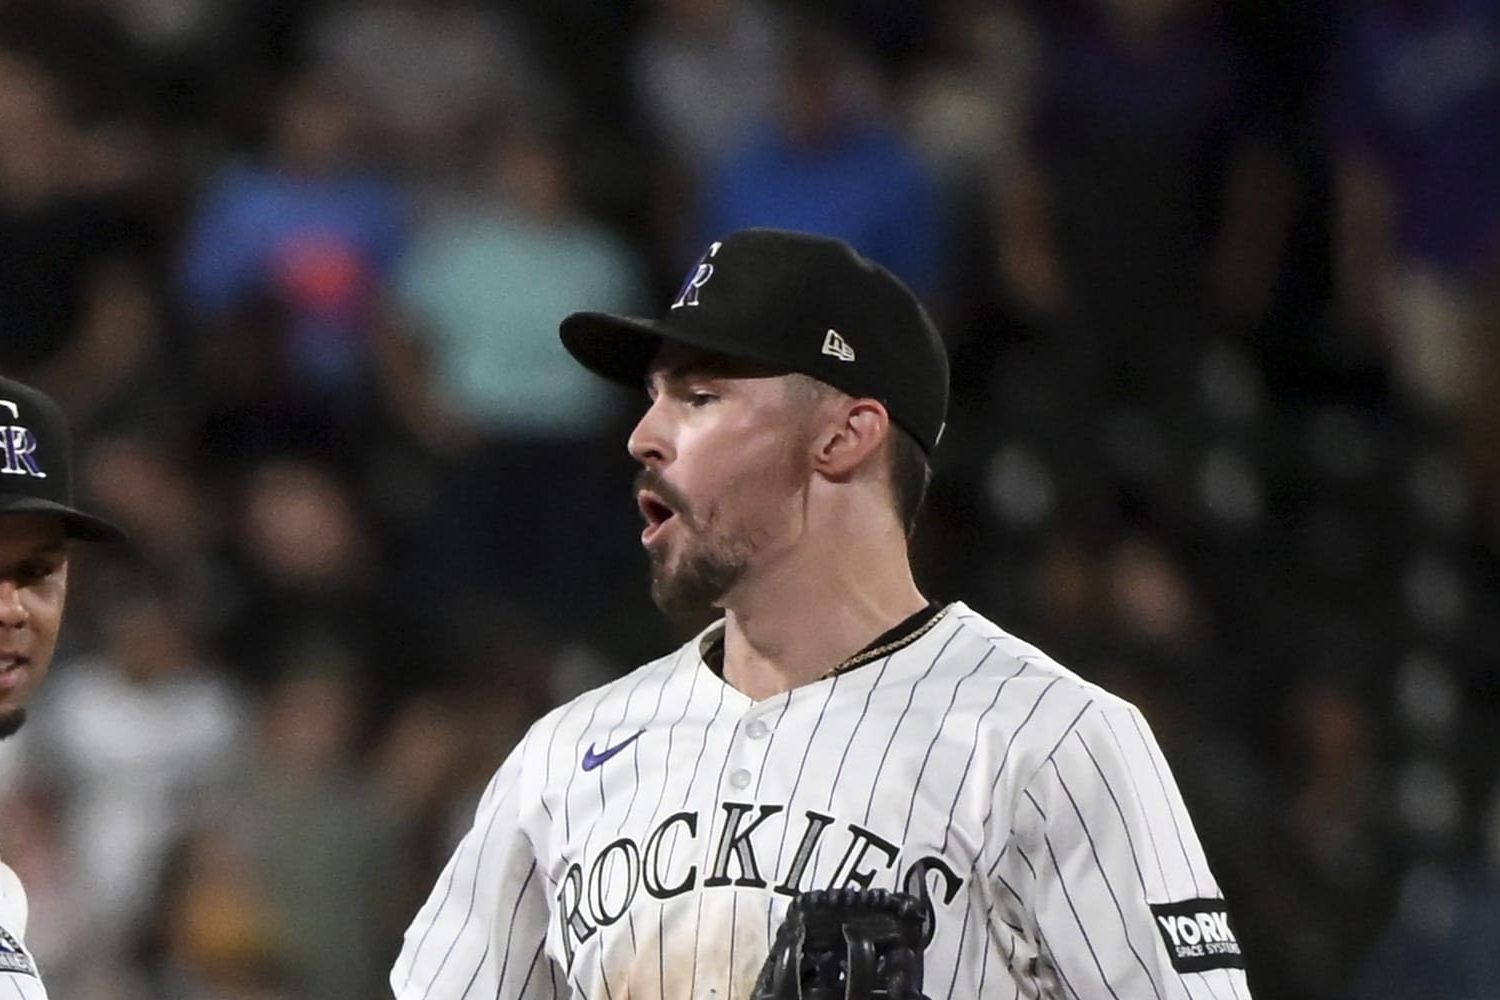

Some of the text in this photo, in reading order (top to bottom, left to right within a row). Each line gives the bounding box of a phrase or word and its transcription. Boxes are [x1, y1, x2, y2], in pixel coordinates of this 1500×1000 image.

[557, 802, 964, 979] ROCKIES
[1158, 912, 1237, 946] YORK
[1175, 944, 1205, 957] SPACE
